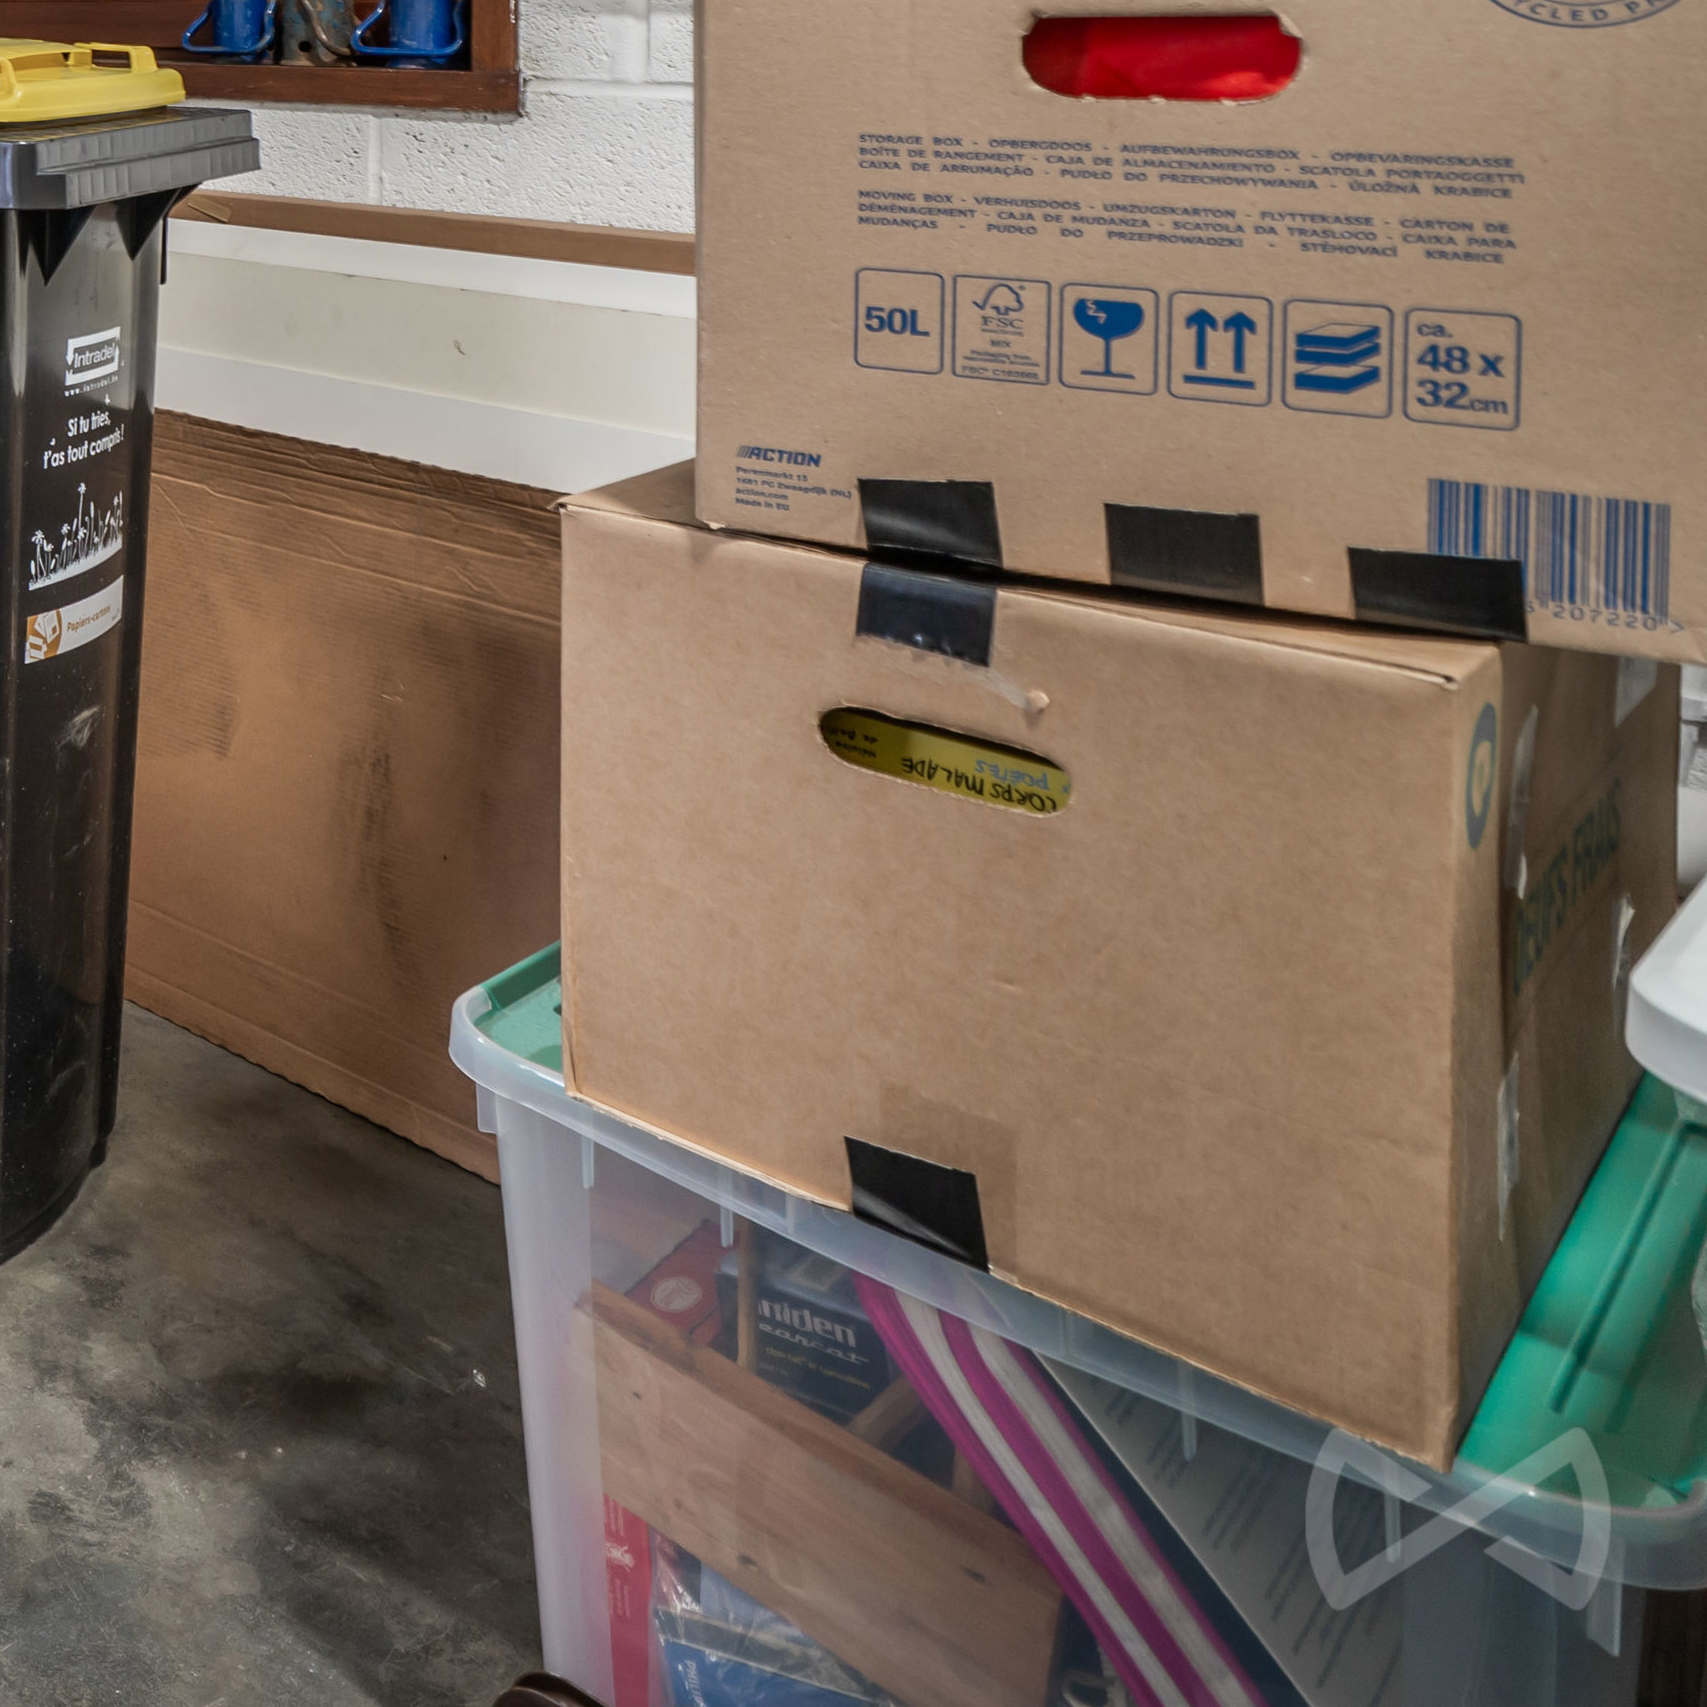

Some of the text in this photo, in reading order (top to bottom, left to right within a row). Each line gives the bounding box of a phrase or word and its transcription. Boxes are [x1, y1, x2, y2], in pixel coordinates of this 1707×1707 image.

[859, 134, 1515, 169] STORAGE BOX OPBERGDOOS AUFBEWAHRUNGSBOX OPBEVARINGSKASSE
[908, 148, 927, 159] DE
[934, 149, 1025, 163] RANGEMENT
[1045, 154, 1085, 166] CAJA
[1093, 156, 1113, 167] DE
[1122, 158, 1276, 174] ALMACENAMIENTO
[1299, 164, 1377, 178] SCATOLA
[1387, 168, 1526, 185] PORTAOGGETTI
[859, 160, 902, 171] CAIXA
[911, 161, 930, 172] DE
[1124, 172, 1148, 182] DO
[1159, 173, 1319, 190] PRZECHOWYWANIA
[1433, 185, 1513, 199] KRABICE
[858, 190, 1511, 234] MOVING BOX VERHUISDOOS UMZUGSKARTON FLYTTEKASSE CARTON DE
[997, 210, 1036, 222] CAJA
[1043, 213, 1064, 224] DE
[1071, 214, 1151, 229] MUDANZA
[1172, 220, 1246, 234] SCATOLA
[1254, 225, 1279, 236] DA
[1286, 226, 1378, 242] TRASLOCO
[1403, 233, 1458, 247] CAIXA
[1468, 237, 1518, 250] PARA
[1061, 228, 1084, 239] DO
[1107, 231, 1244, 248] PRZEPROWADZKI
[1424, 249, 1505, 265] KRABICE
[864, 305, 931, 338] 50L
[981, 315, 1025, 330] FSC
[1416, 321, 1454, 338] ca.
[74, 343, 116, 369] Intradel
[1416, 344, 1506, 378] 48 x
[1416, 378, 1509, 415] 32cm
[67, 418, 78, 437] Si
[79, 415, 90, 433] tu
[67, 441, 89, 463] tout
[745, 446, 822, 468] ACTION
[900, 756, 985, 792] MALADE
[758, 1297, 857, 1349] niden
[758, 1322, 870, 1366] earcat
